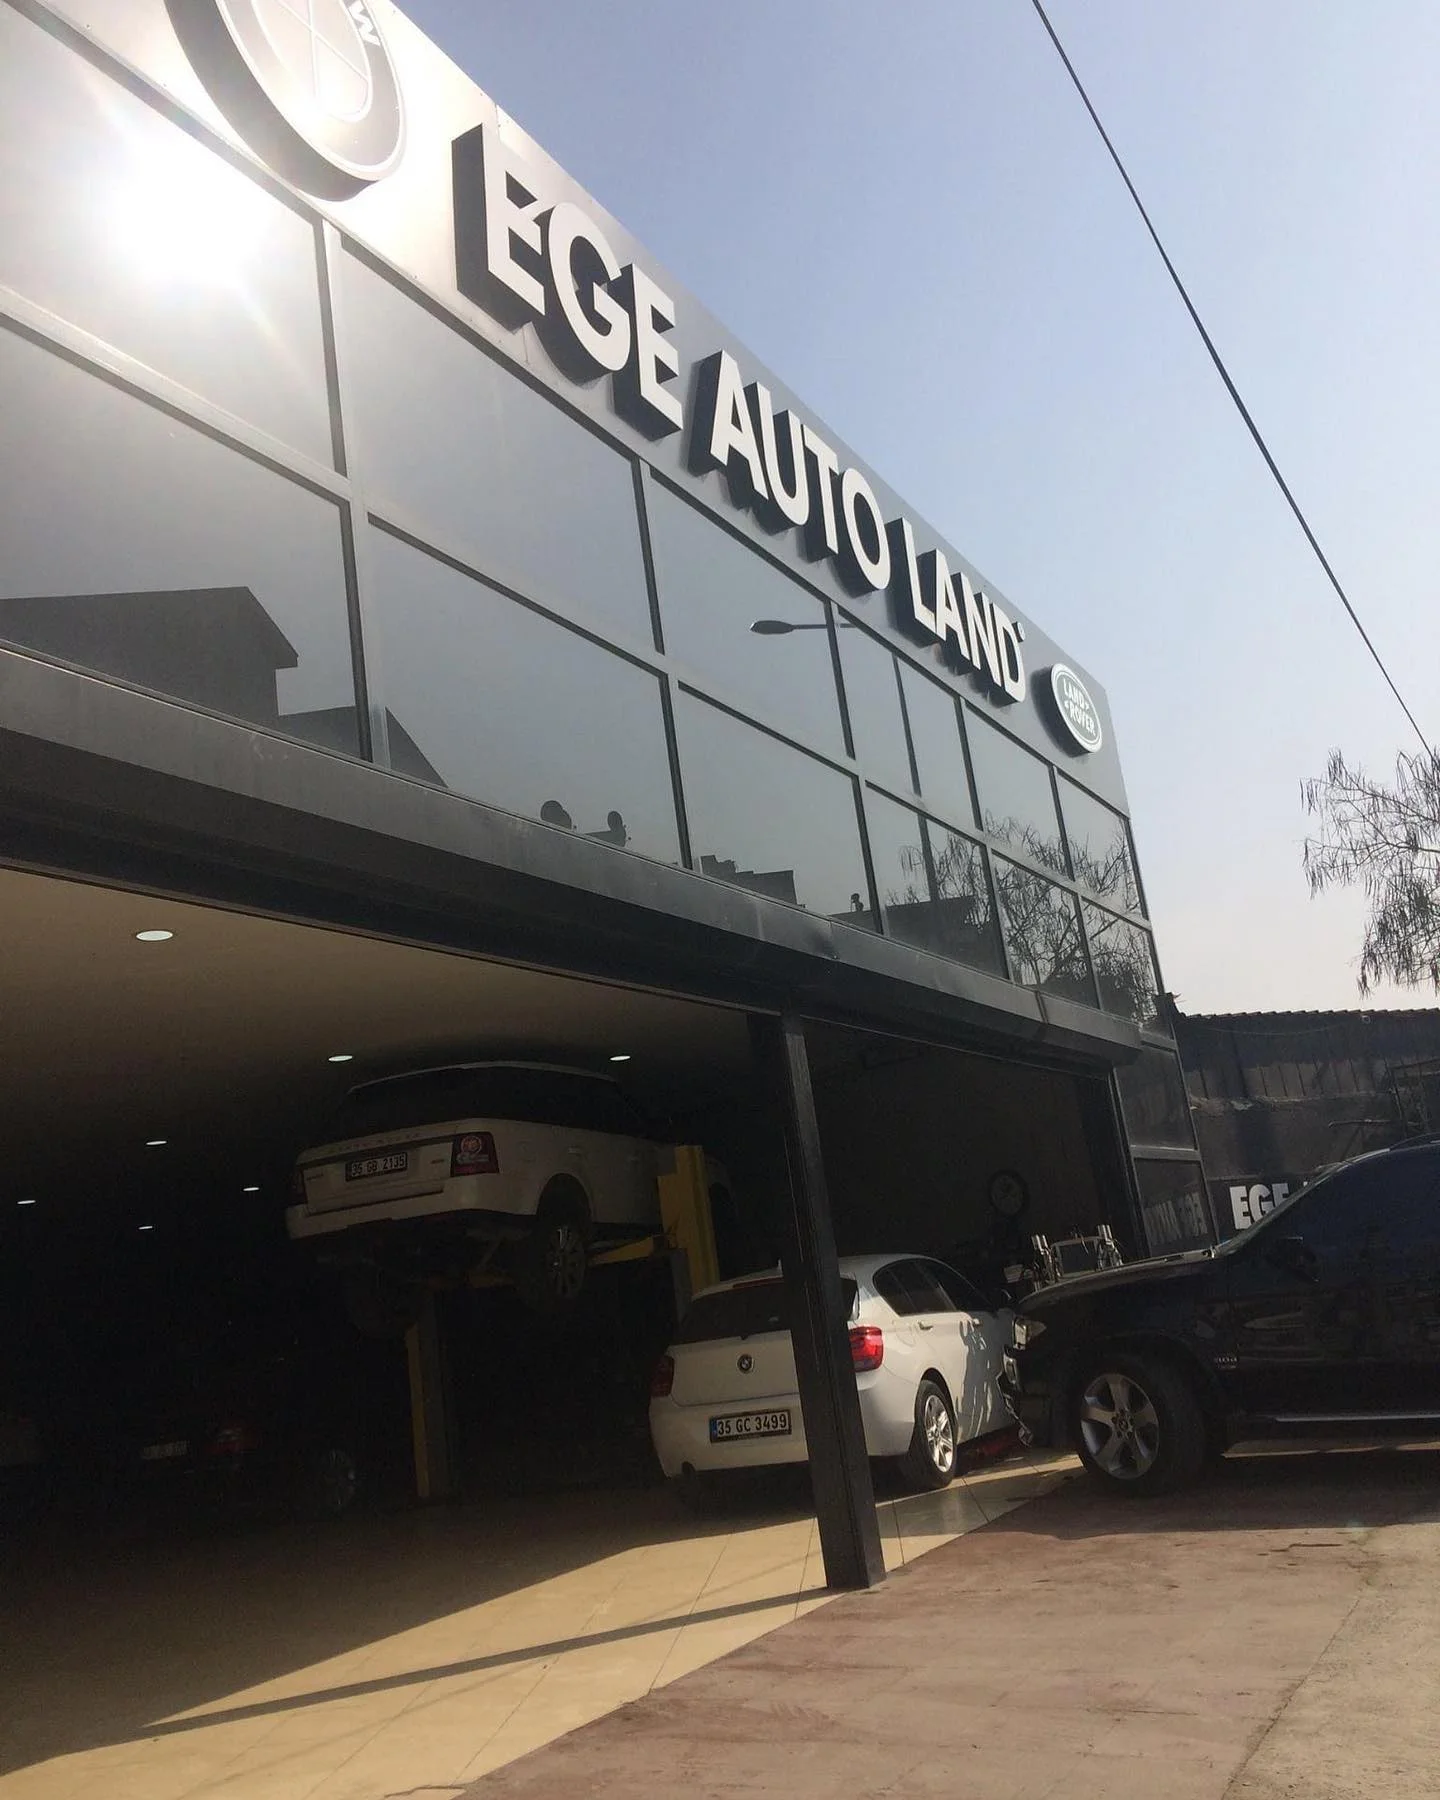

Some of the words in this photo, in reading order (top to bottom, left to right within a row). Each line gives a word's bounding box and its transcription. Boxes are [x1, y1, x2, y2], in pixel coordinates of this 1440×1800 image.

[481, 122, 683, 430] EGE
[710, 349, 890, 590] AUTO
[1063, 678, 1086, 710] LAND
[1068, 700, 1096, 737] ROVER
[718, 1420, 731, 1435] 35
[736, 1417, 751, 1433] GC
[755, 1413, 787, 1431] 3499
